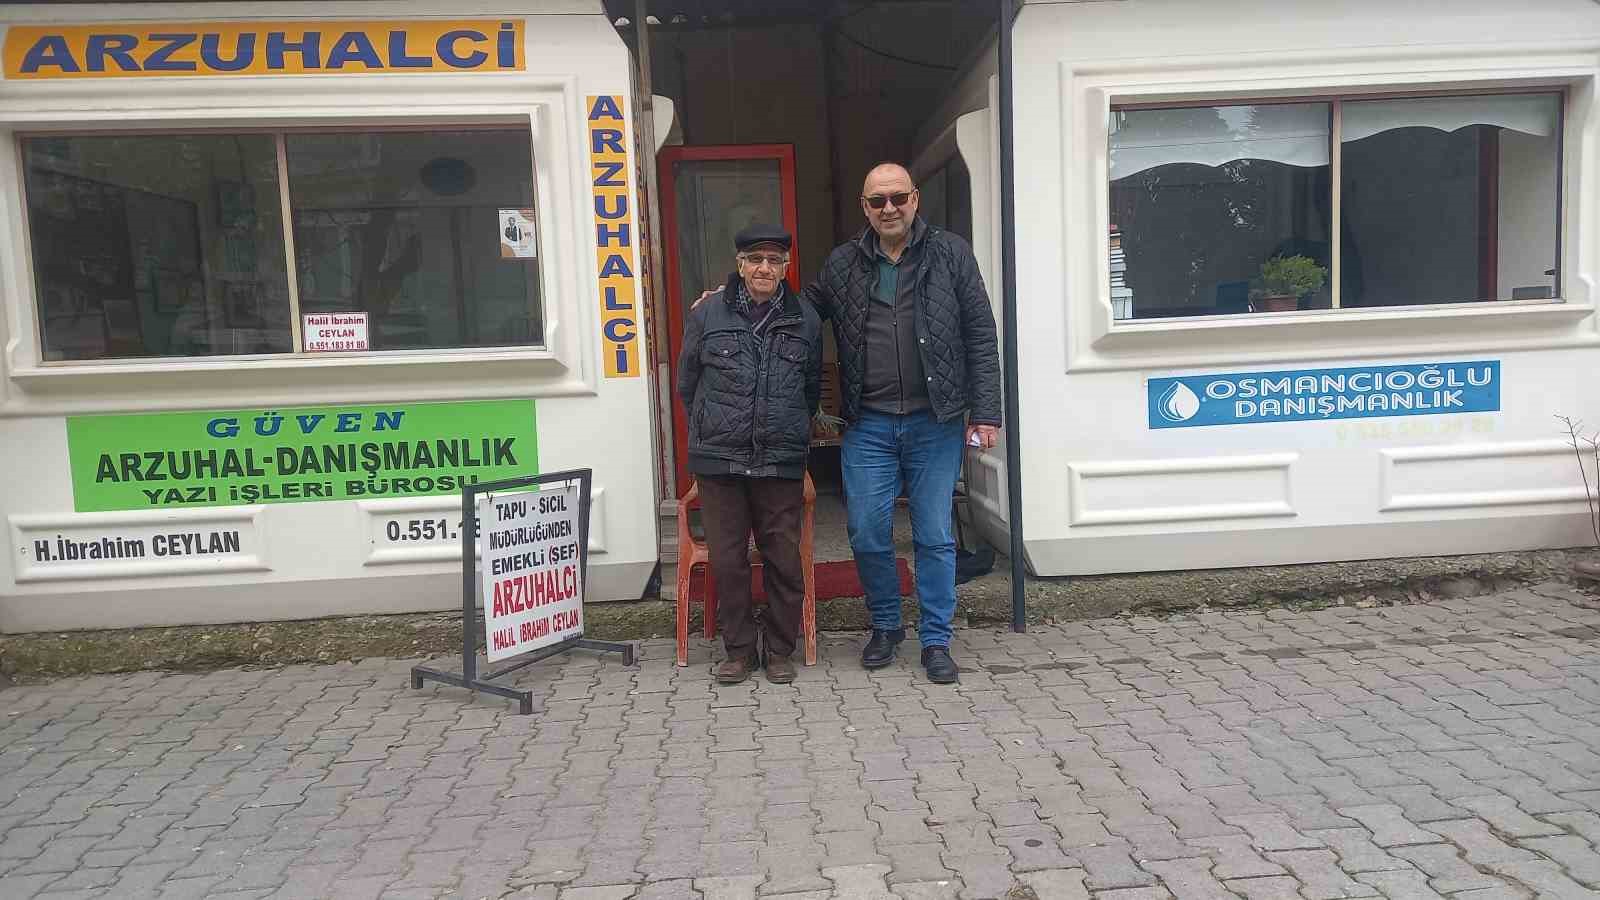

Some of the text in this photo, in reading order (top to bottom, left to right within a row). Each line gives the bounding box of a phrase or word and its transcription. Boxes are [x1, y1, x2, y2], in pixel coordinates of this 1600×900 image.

[19, 22, 516, 73] ARZUHALCİ
[588, 95, 636, 374] ARZUHALCİ
[307, 316, 329, 326] Halil
[318, 329, 355, 338] CEYLAN
[1205, 364, 1493, 399] OSMANCIOĞLU
[1234, 390, 1464, 418] DANIŞMANLIK
[206, 411, 406, 438] GÜVEN
[96, 437, 518, 483] ARZUHAL-DANIŞMANLIK
[142, 486, 217, 505] YAZI
[495, 500, 527, 522] TAPU
[34, 531, 241, 562] H.İbrahim CEYLAN
[489, 519, 572, 551] MÜDÜRLÜĞÜNDEN
[548, 541, 579, 565] (ŞEF)
[553, 608, 579, 632] CEYLAN
